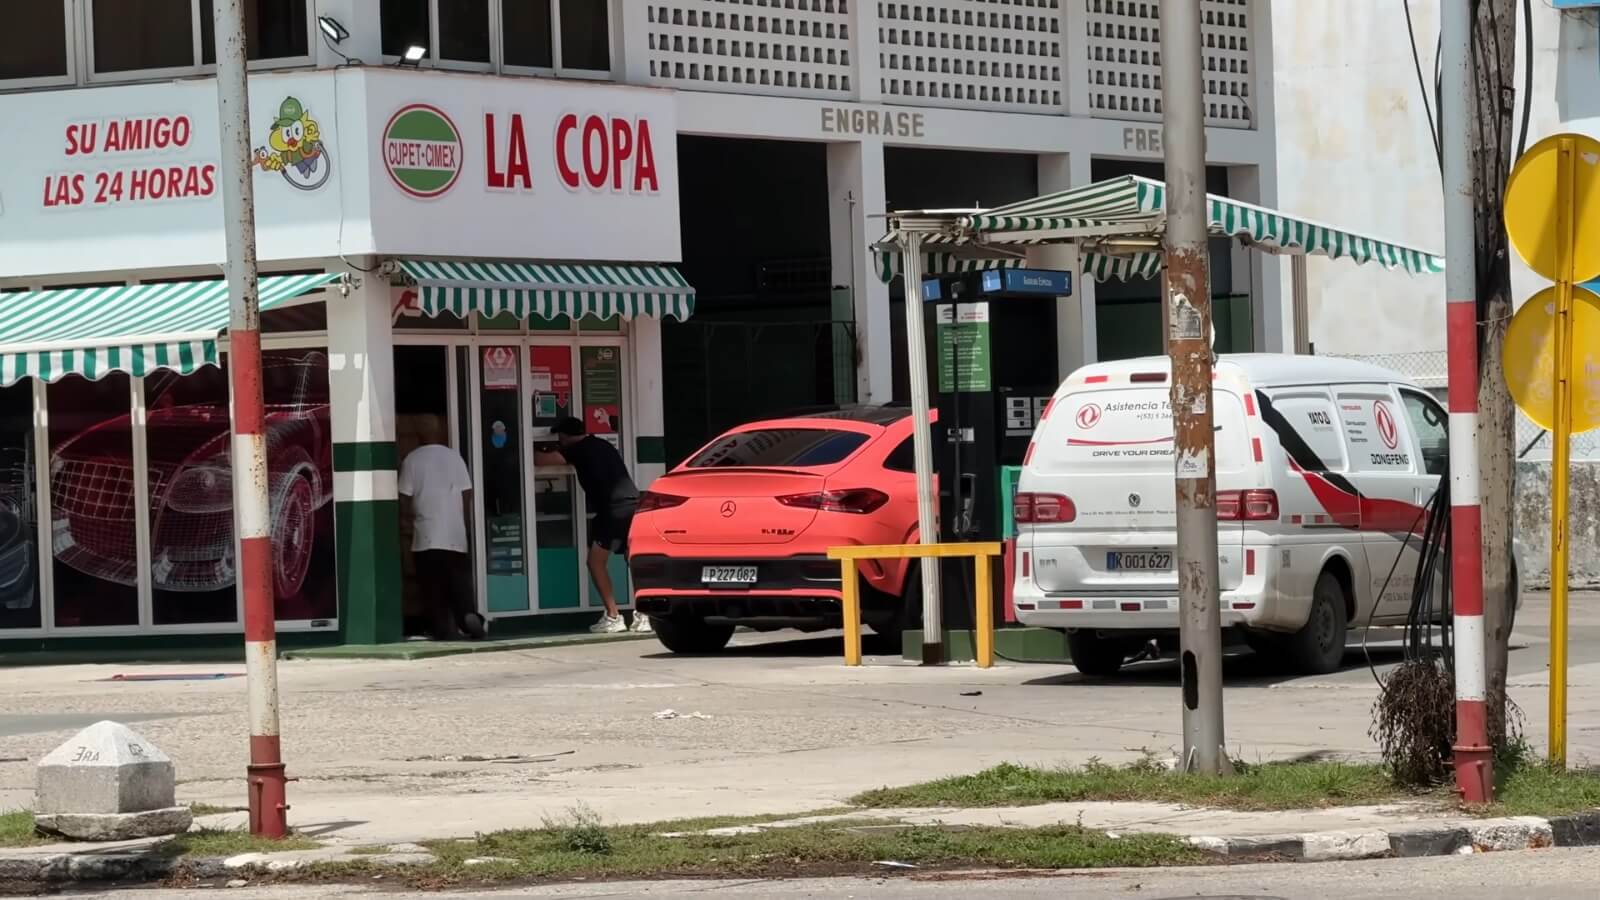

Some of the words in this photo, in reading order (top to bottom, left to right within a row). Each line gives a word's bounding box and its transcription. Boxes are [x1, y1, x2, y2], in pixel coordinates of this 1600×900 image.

[821, 107, 925, 138] ENGRASE
[64, 123, 97, 155] SU
[103, 116, 191, 152] AMIGO
[388, 142, 456, 168] CUPET-CIMEX
[485, 113, 533, 189] LA
[555, 113, 659, 192] COPA
[42, 174, 85, 207] LAS
[94, 171, 123, 203] 24
[130, 164, 216, 200] HORAS
[1104, 401, 1158, 411] Asistencia
[1121, 449, 1148, 457] YOUR
[1370, 453, 1410, 465] DONGFENG
[1125, 555, 1146, 568] 001
[1149, 555, 1170, 568] 627
[709, 568, 716, 580] P
[717, 568, 735, 581] 227
[737, 568, 756, 581] 082
